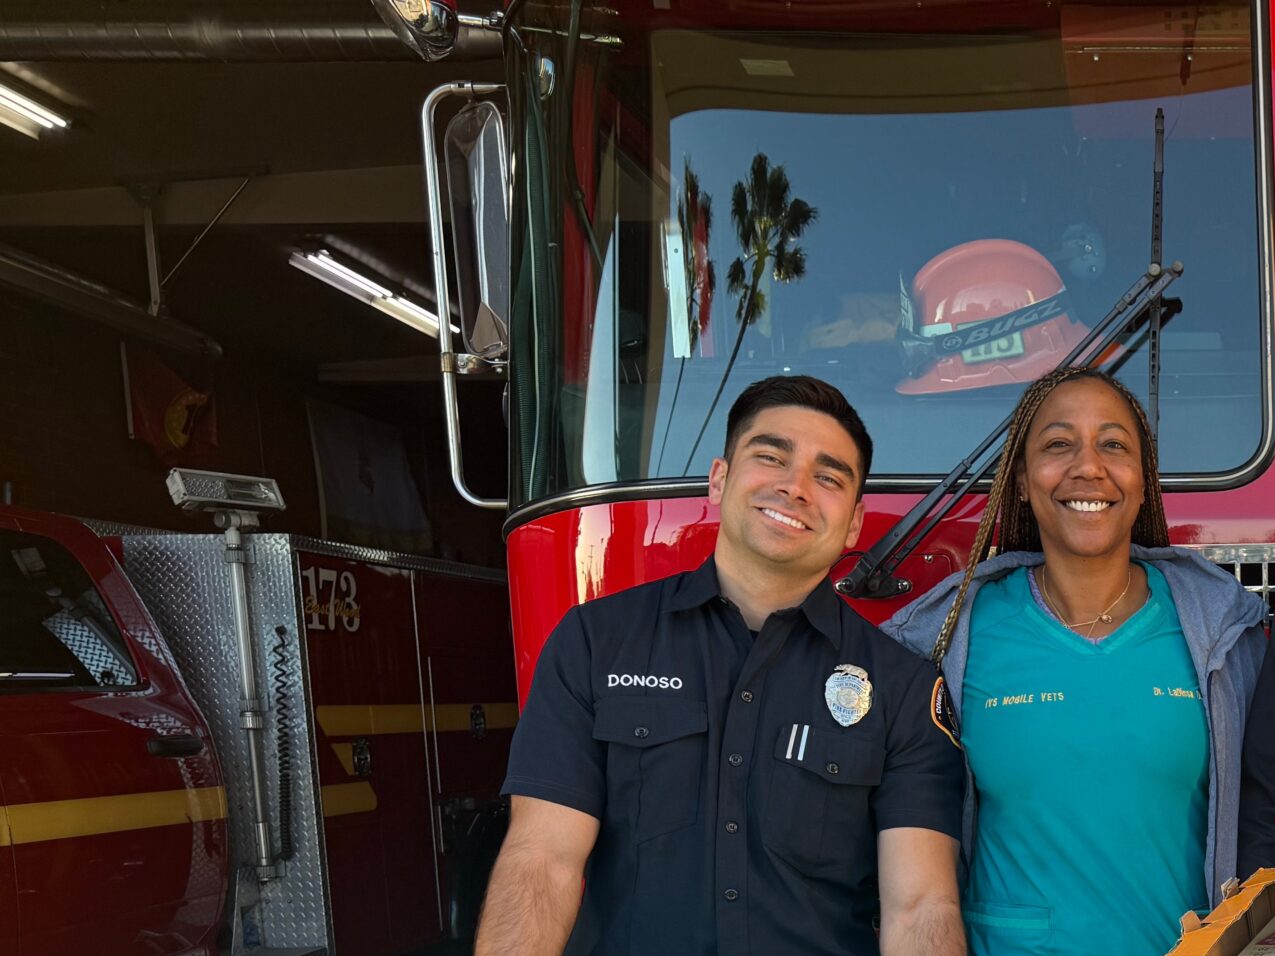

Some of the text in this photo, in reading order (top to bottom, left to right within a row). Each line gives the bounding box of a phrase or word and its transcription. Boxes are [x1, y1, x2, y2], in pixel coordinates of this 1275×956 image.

[965, 300, 1062, 344] BUGZ
[302, 566, 360, 632] 173
[607, 673, 683, 690] DONOSO
[1002, 693, 1034, 706] MOBILE
[1041, 692, 1065, 703] VETS
